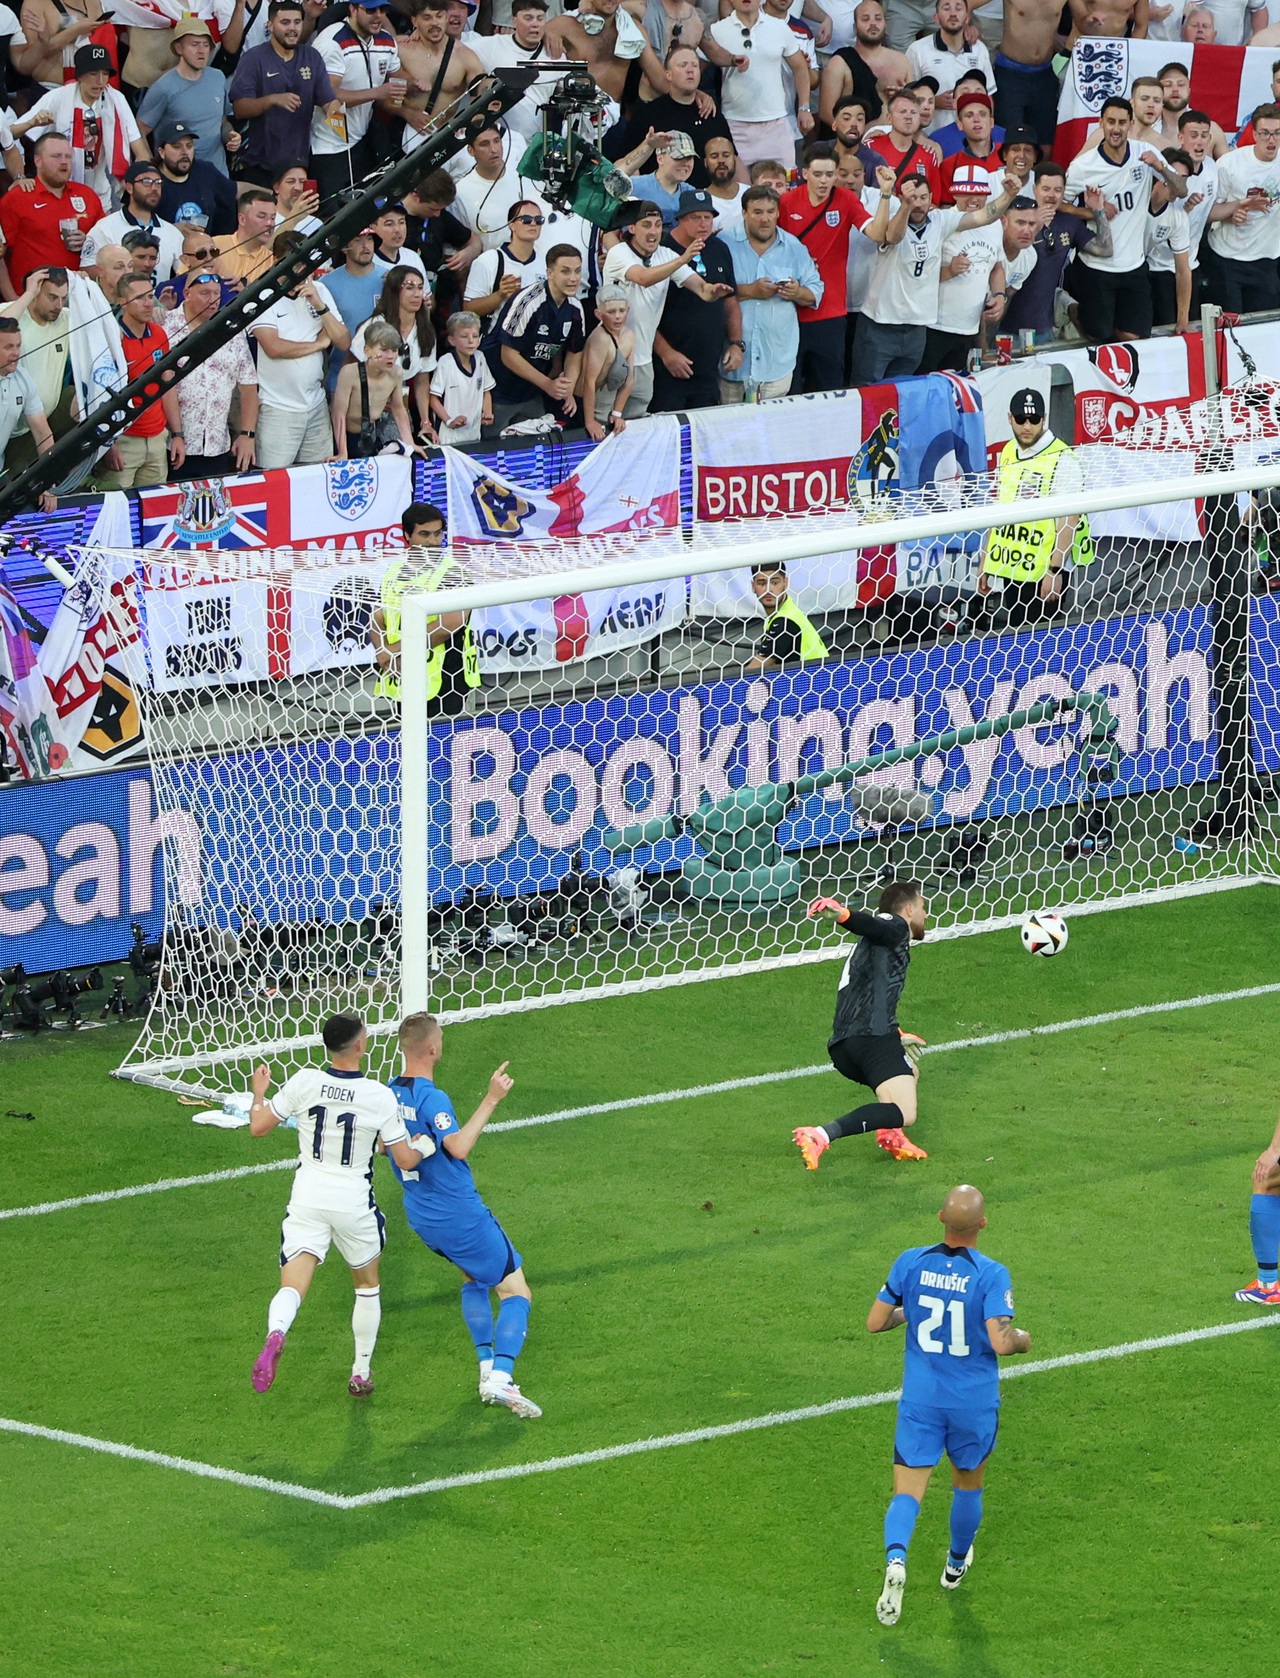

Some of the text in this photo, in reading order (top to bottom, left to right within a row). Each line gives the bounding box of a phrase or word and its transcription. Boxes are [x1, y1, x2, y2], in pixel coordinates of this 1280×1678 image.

[93, 48, 105, 59] N
[1114, 191, 1134, 211] 10
[914, 261, 925, 277] 8
[705, 468, 845, 515] BRISTOL
[181, 525, 229, 541] NEWCASTLE UNITED
[307, 527, 407, 565] MAGS
[990, 544, 1036, 571] 0098
[451, 622, 1213, 866] Booking.yeah
[320, 1084, 355, 1103] FODEN
[308, 1105, 358, 1168] 11
[919, 1270, 971, 1294] DRKUŠIĆ
[917, 1294, 970, 1357] 21
